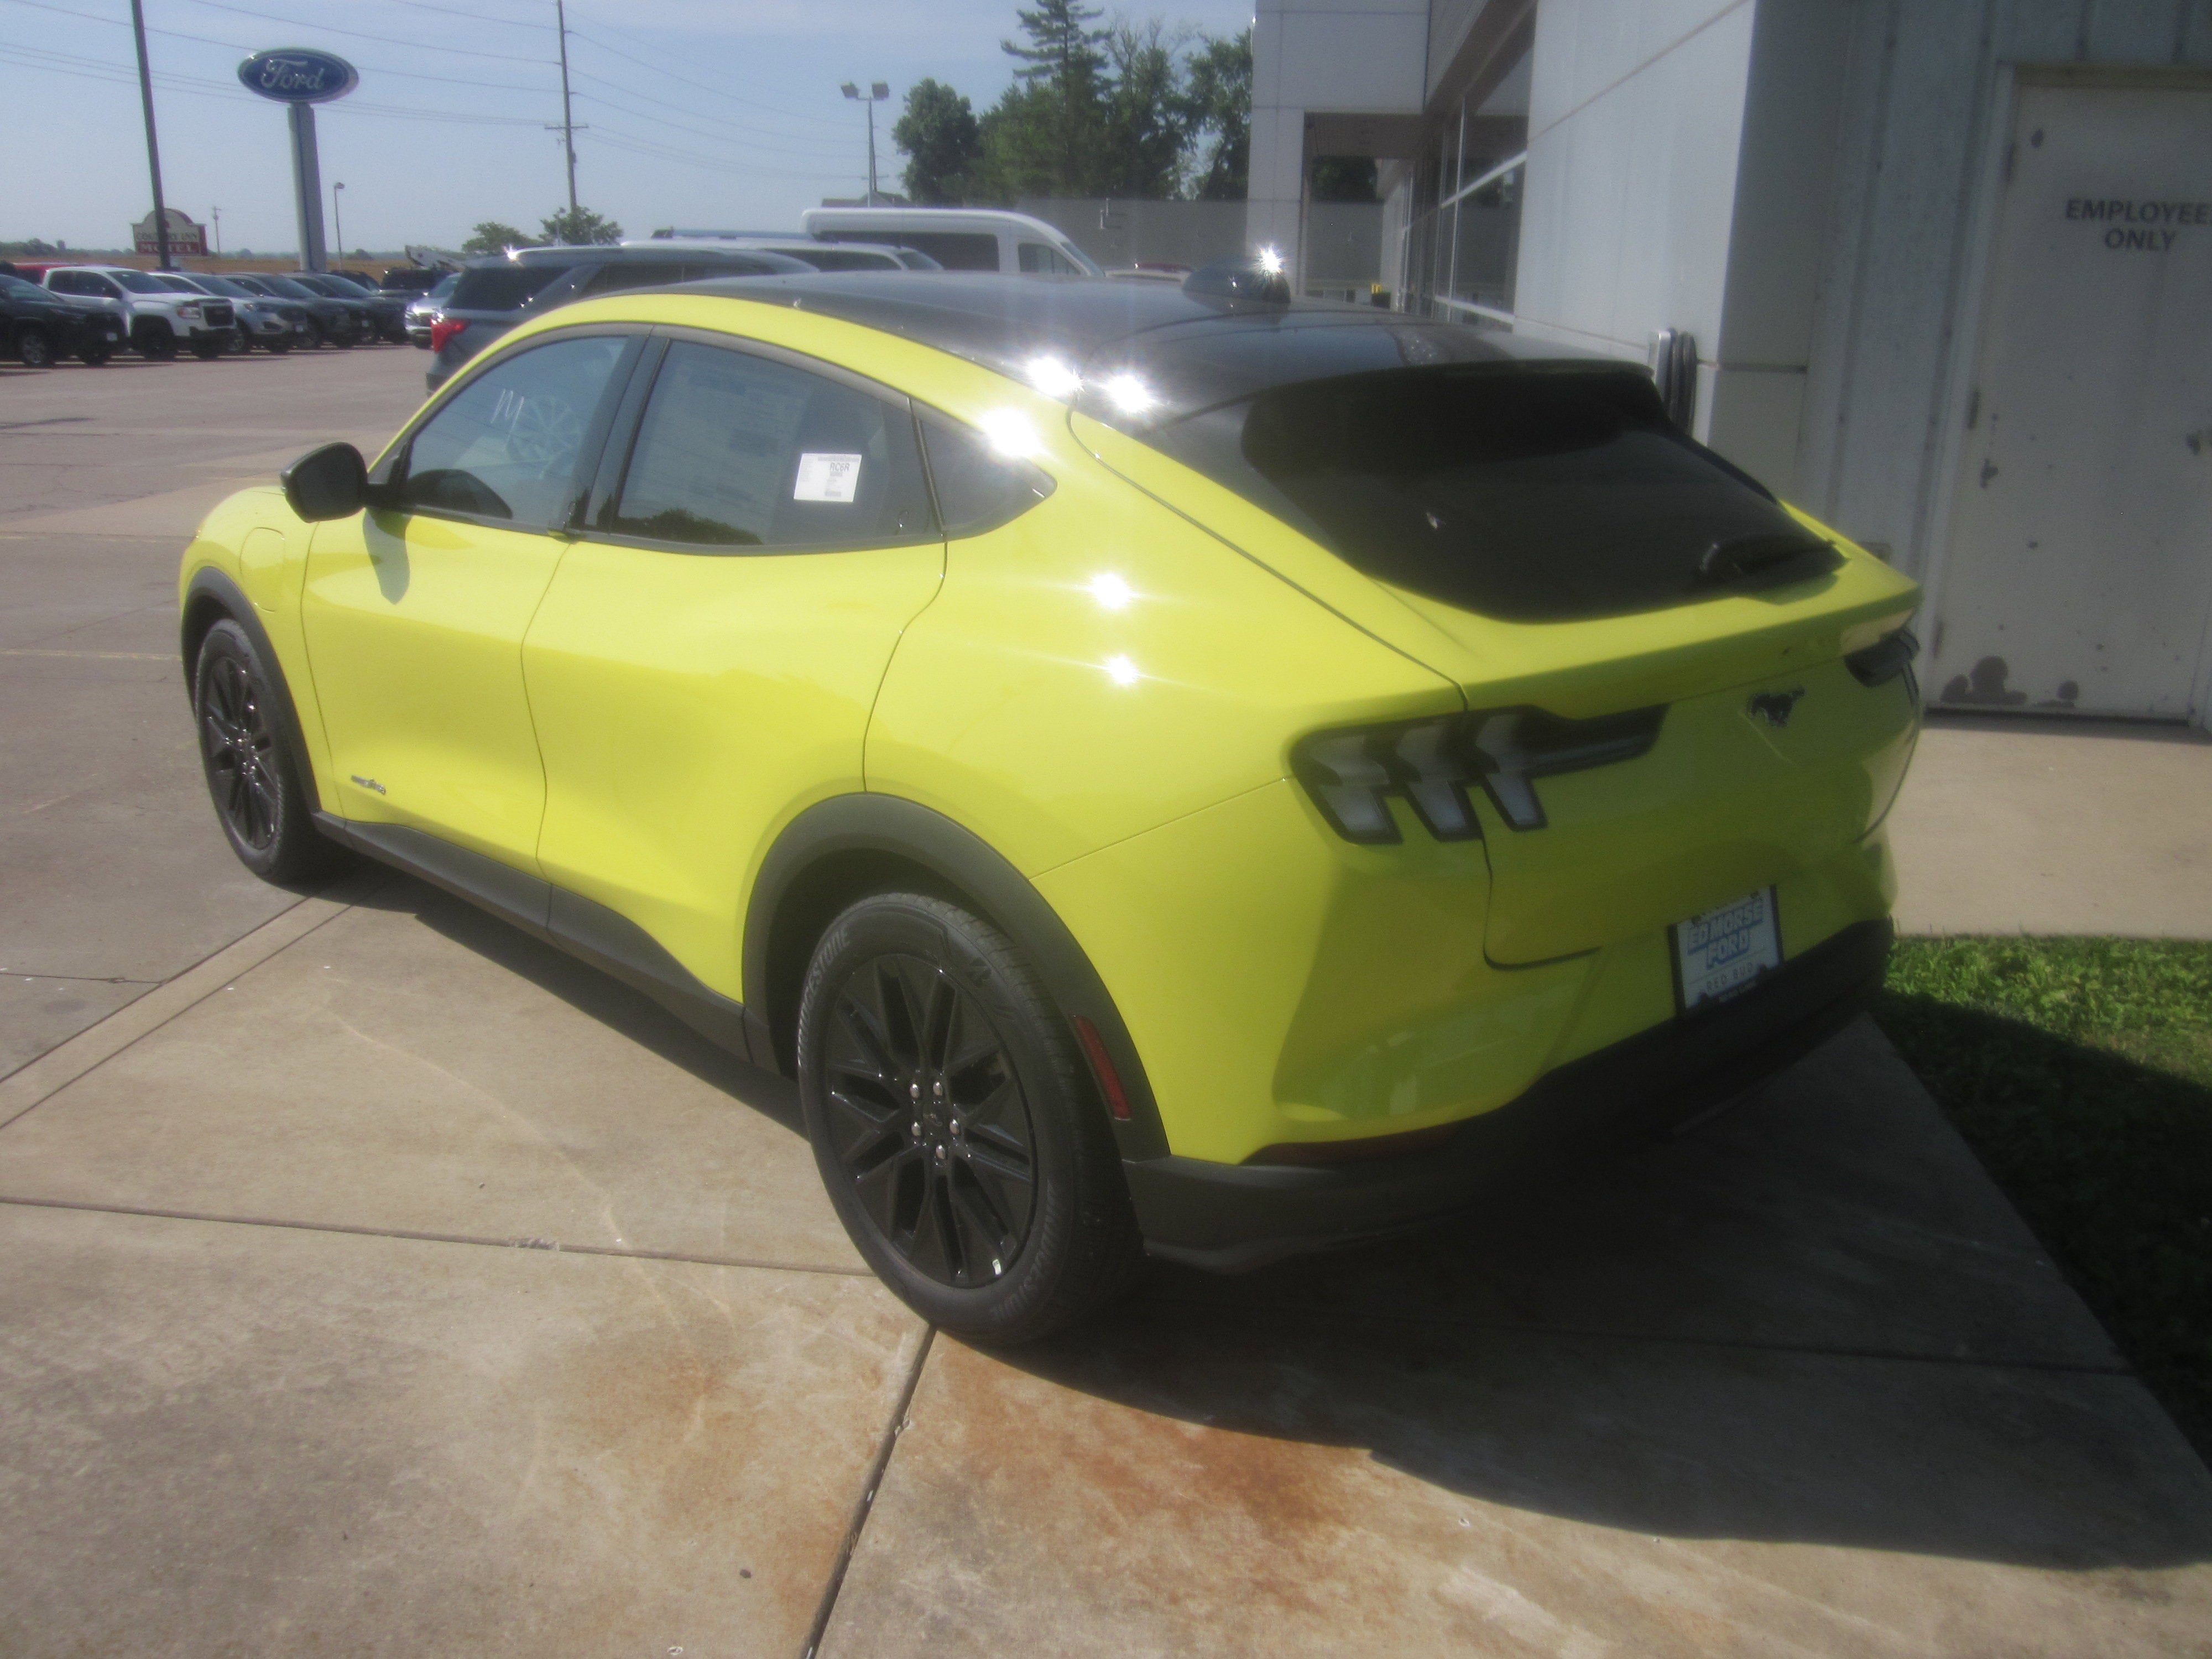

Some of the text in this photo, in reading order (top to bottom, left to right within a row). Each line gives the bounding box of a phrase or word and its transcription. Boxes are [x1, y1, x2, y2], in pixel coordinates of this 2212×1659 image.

[261, 59, 325, 90] Ford
[2105, 228, 2177, 250] ONLY
[1688, 896, 1763, 953] ED MORSE
[1707, 929, 1750, 969] FORD
[1706, 975, 1726, 992] RED
[1734, 962, 1754, 979] BUD
